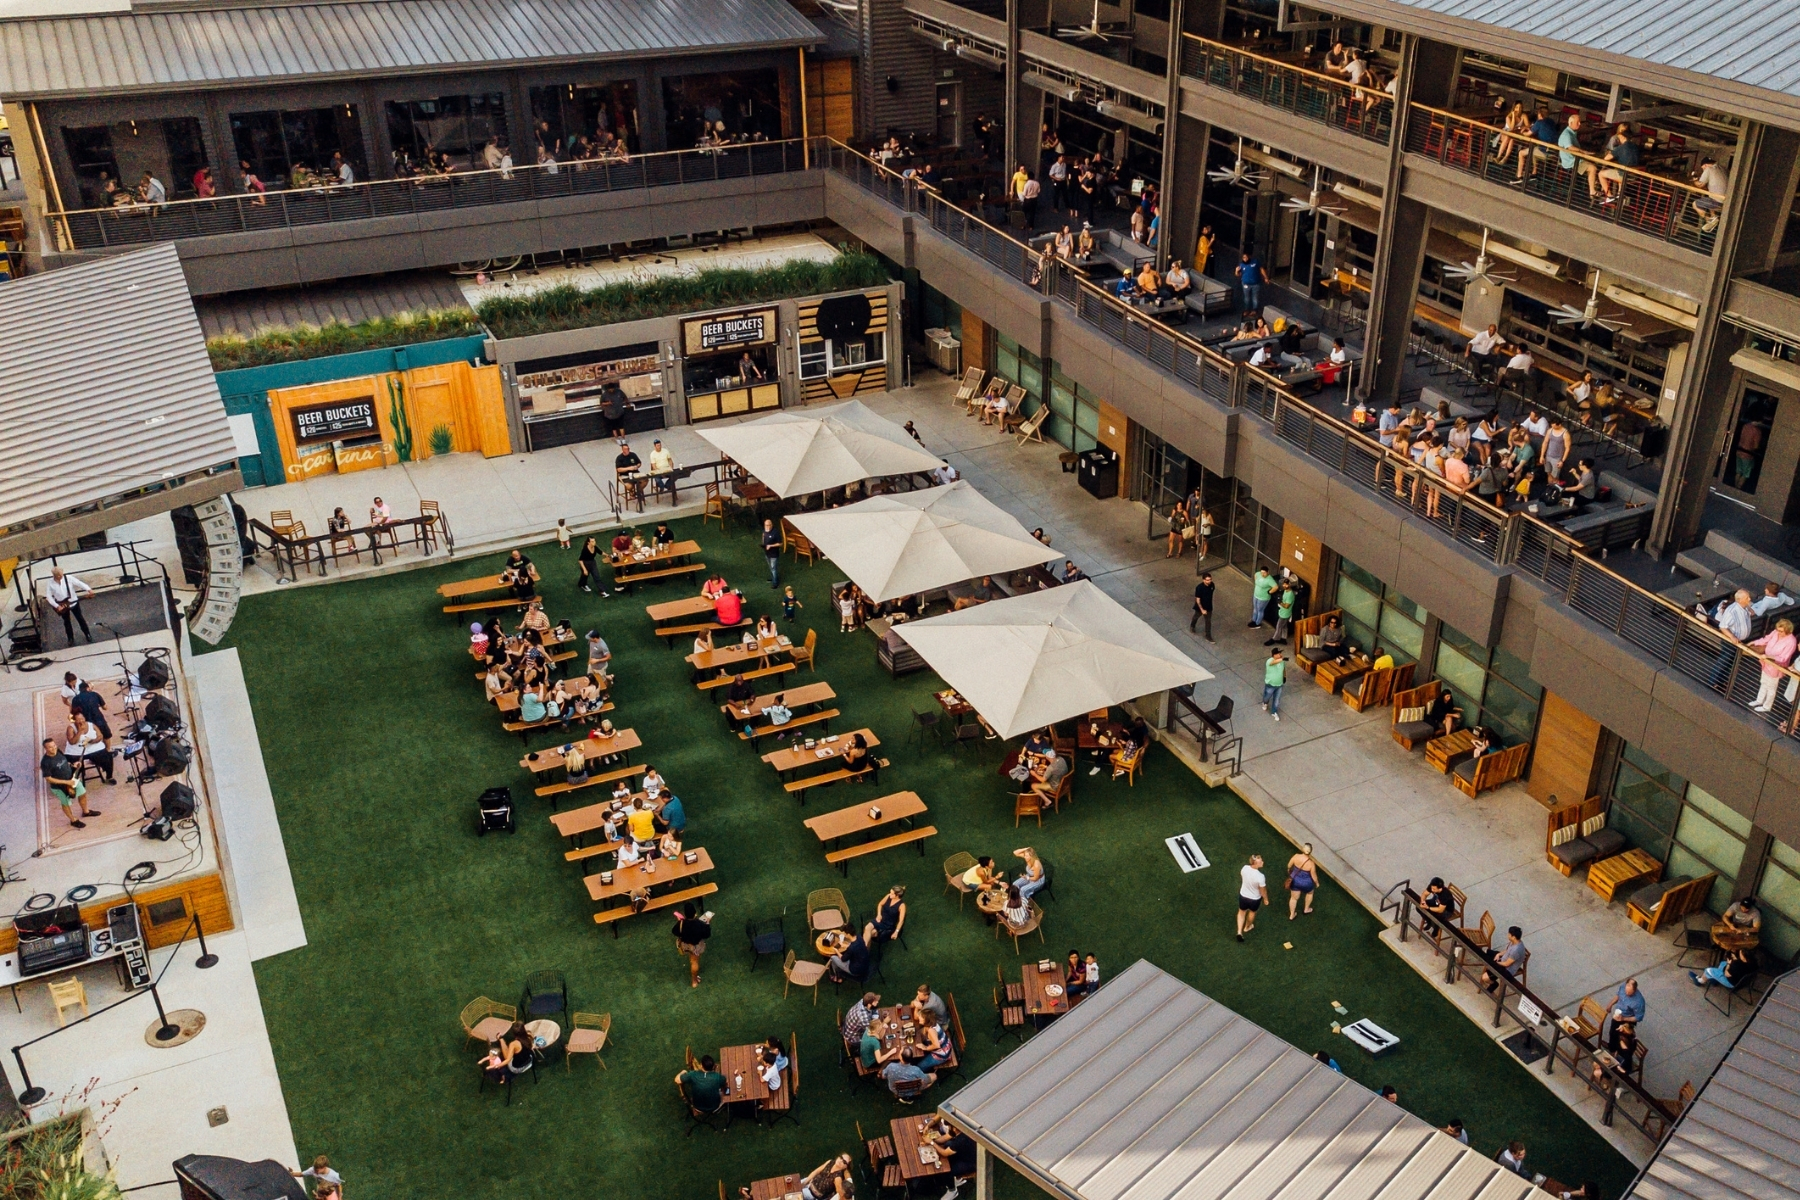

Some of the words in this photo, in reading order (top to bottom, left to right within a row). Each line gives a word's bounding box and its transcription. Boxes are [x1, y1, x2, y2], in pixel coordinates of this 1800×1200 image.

[702, 323, 723, 336] BEER
[725, 318, 763, 333] BUCKETS
[522, 365, 603, 389] STILLHOUSE
[606, 356, 656, 376] LOUNGE
[297, 411, 323, 425] BEER
[325, 404, 371, 421] BUCKETS
